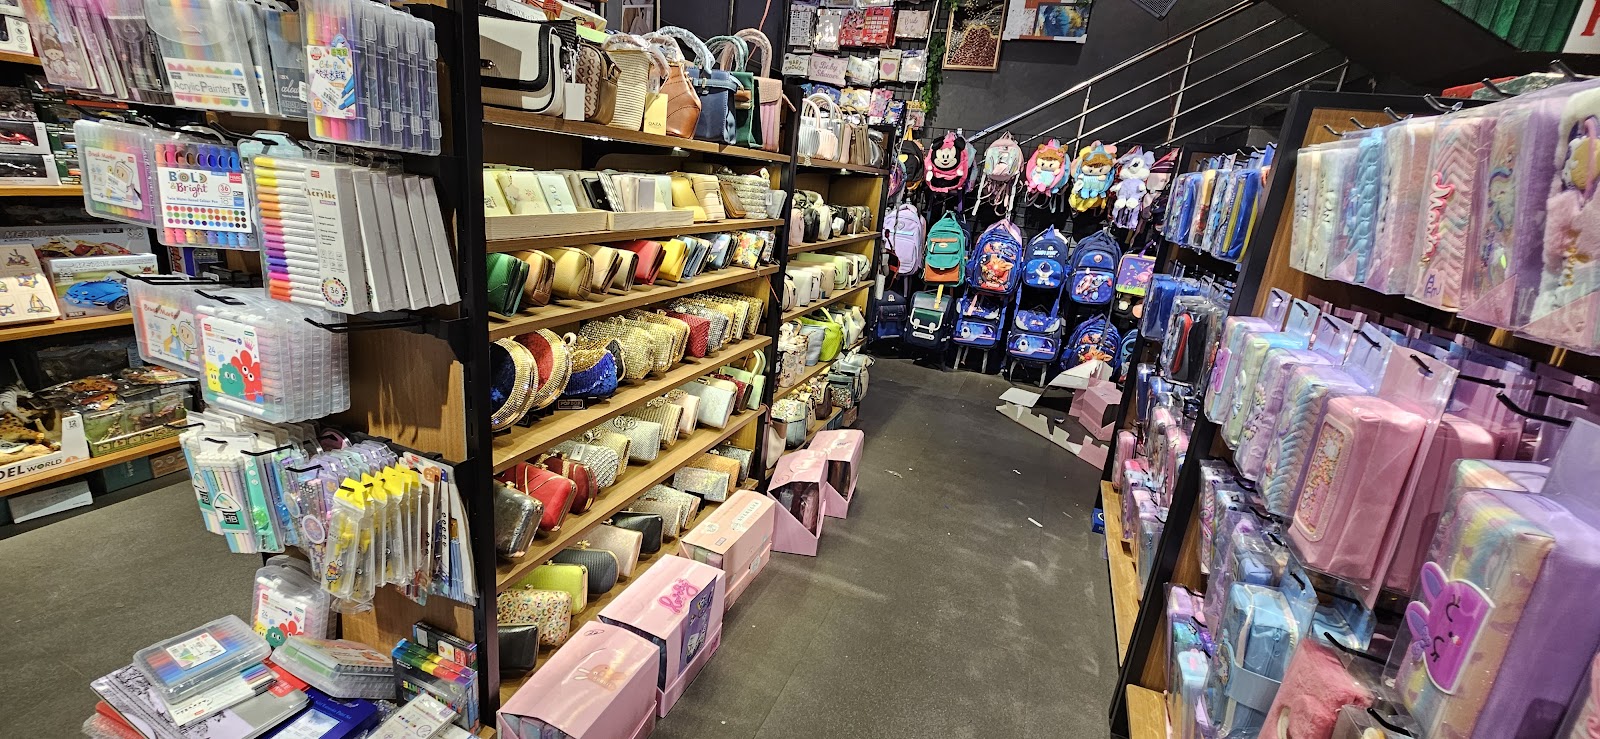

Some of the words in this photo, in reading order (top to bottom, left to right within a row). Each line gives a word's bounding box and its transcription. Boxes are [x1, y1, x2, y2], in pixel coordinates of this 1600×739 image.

[168, 170, 208, 184] BOLD
[176, 182, 208, 198] Bright
[220, 184, 229, 192] 36
[330, 286, 340, 295] 36
[207, 345, 216, 354] 24
[26, 458, 63, 473] WORLD
